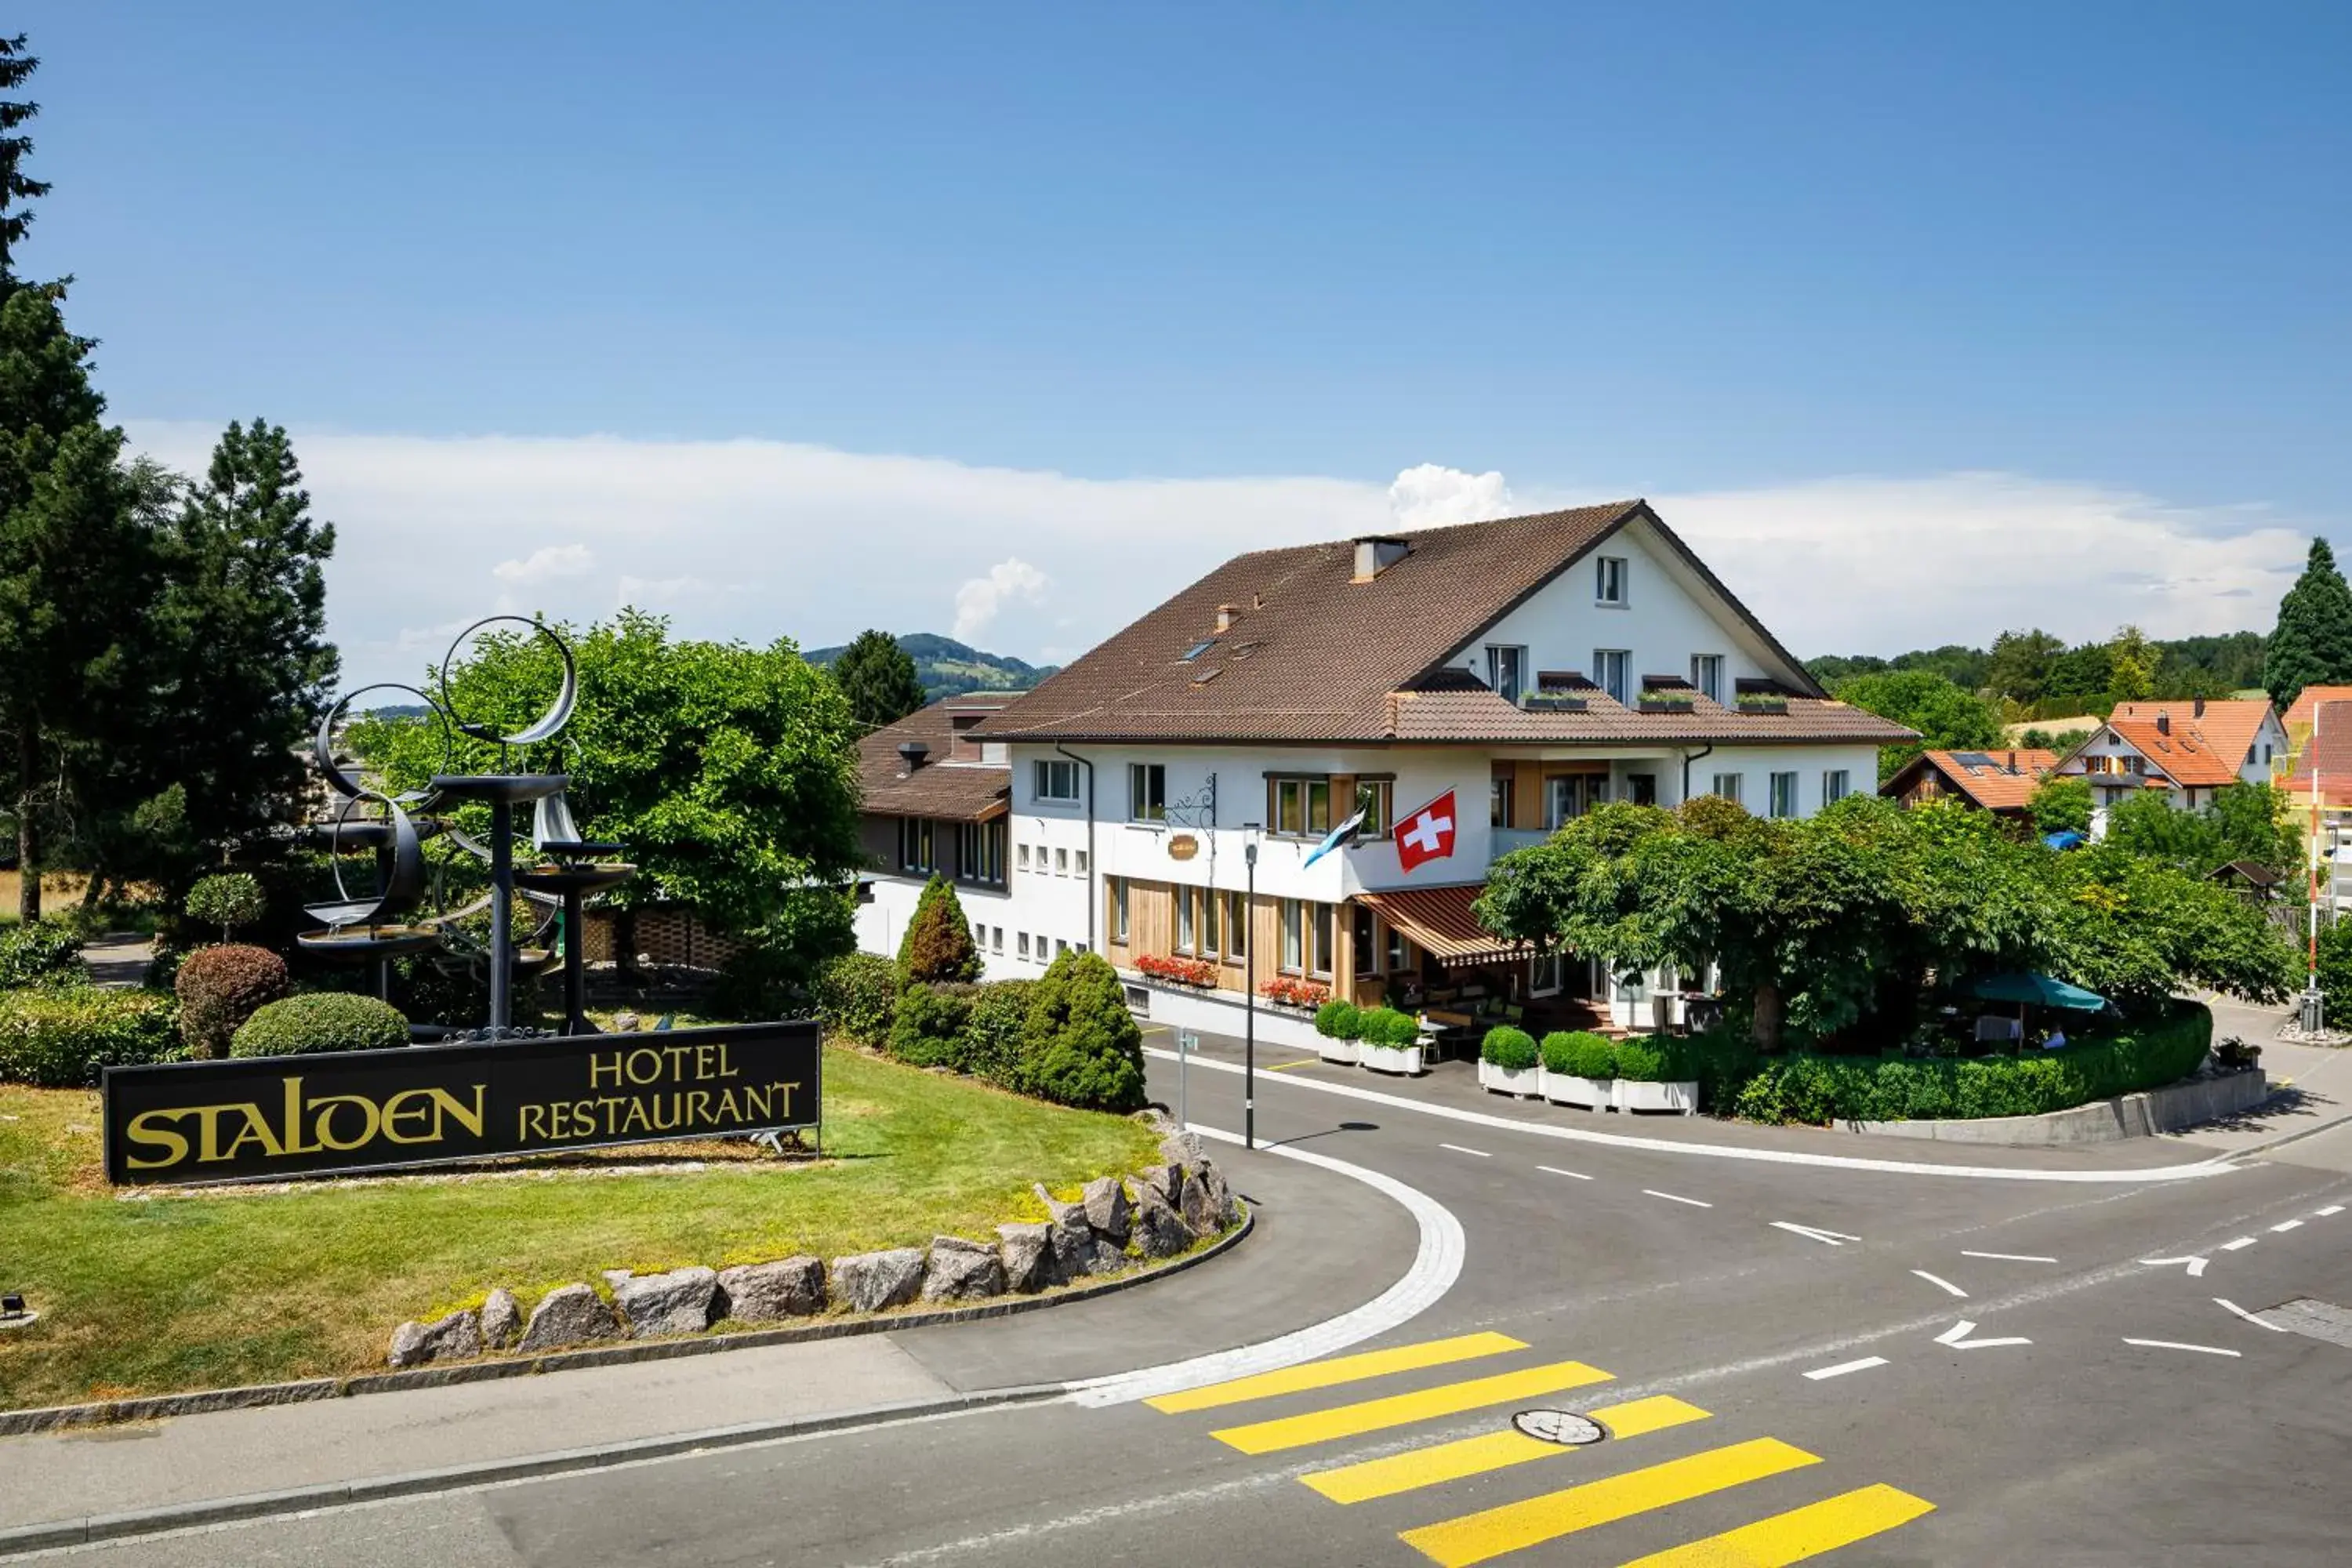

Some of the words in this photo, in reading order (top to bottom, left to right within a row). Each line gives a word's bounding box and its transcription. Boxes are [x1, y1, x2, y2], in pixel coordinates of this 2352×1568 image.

[590, 1044, 739, 1088] HOTEL
[126, 1076, 486, 1169] STALDEN
[519, 1081, 800, 1142] RESTAURANT
